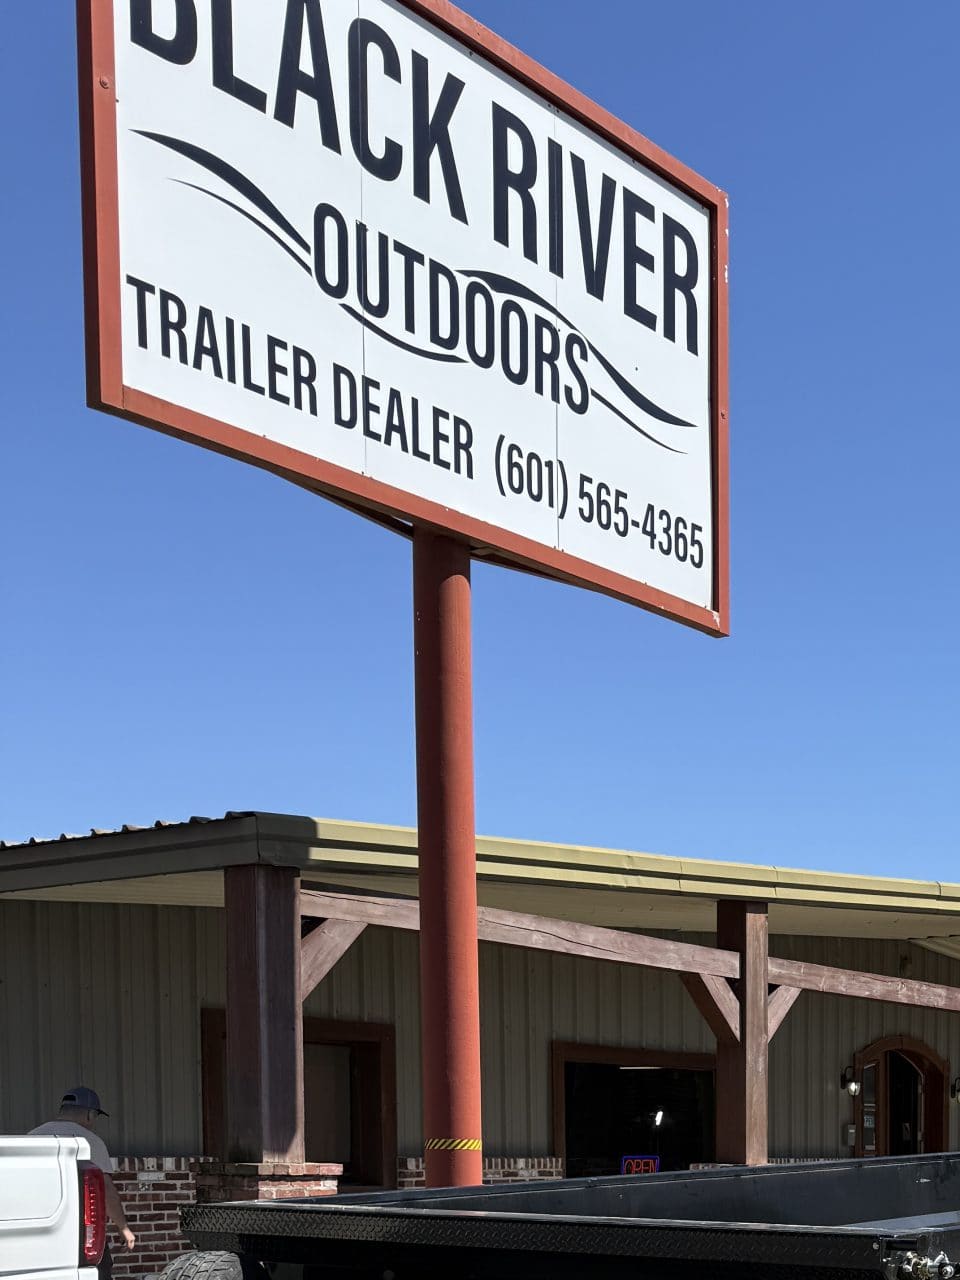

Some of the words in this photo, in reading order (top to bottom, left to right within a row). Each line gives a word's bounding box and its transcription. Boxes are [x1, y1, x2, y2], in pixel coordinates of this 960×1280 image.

[313, 202, 589, 415] OUTDOORS
[492, 100, 699, 357] RIVER
[126, 274, 318, 417] TRAILER
[333, 362, 474, 480] DEALER
[494, 434, 568, 520] (601)
[578, 473, 704, 569] 565-4365
